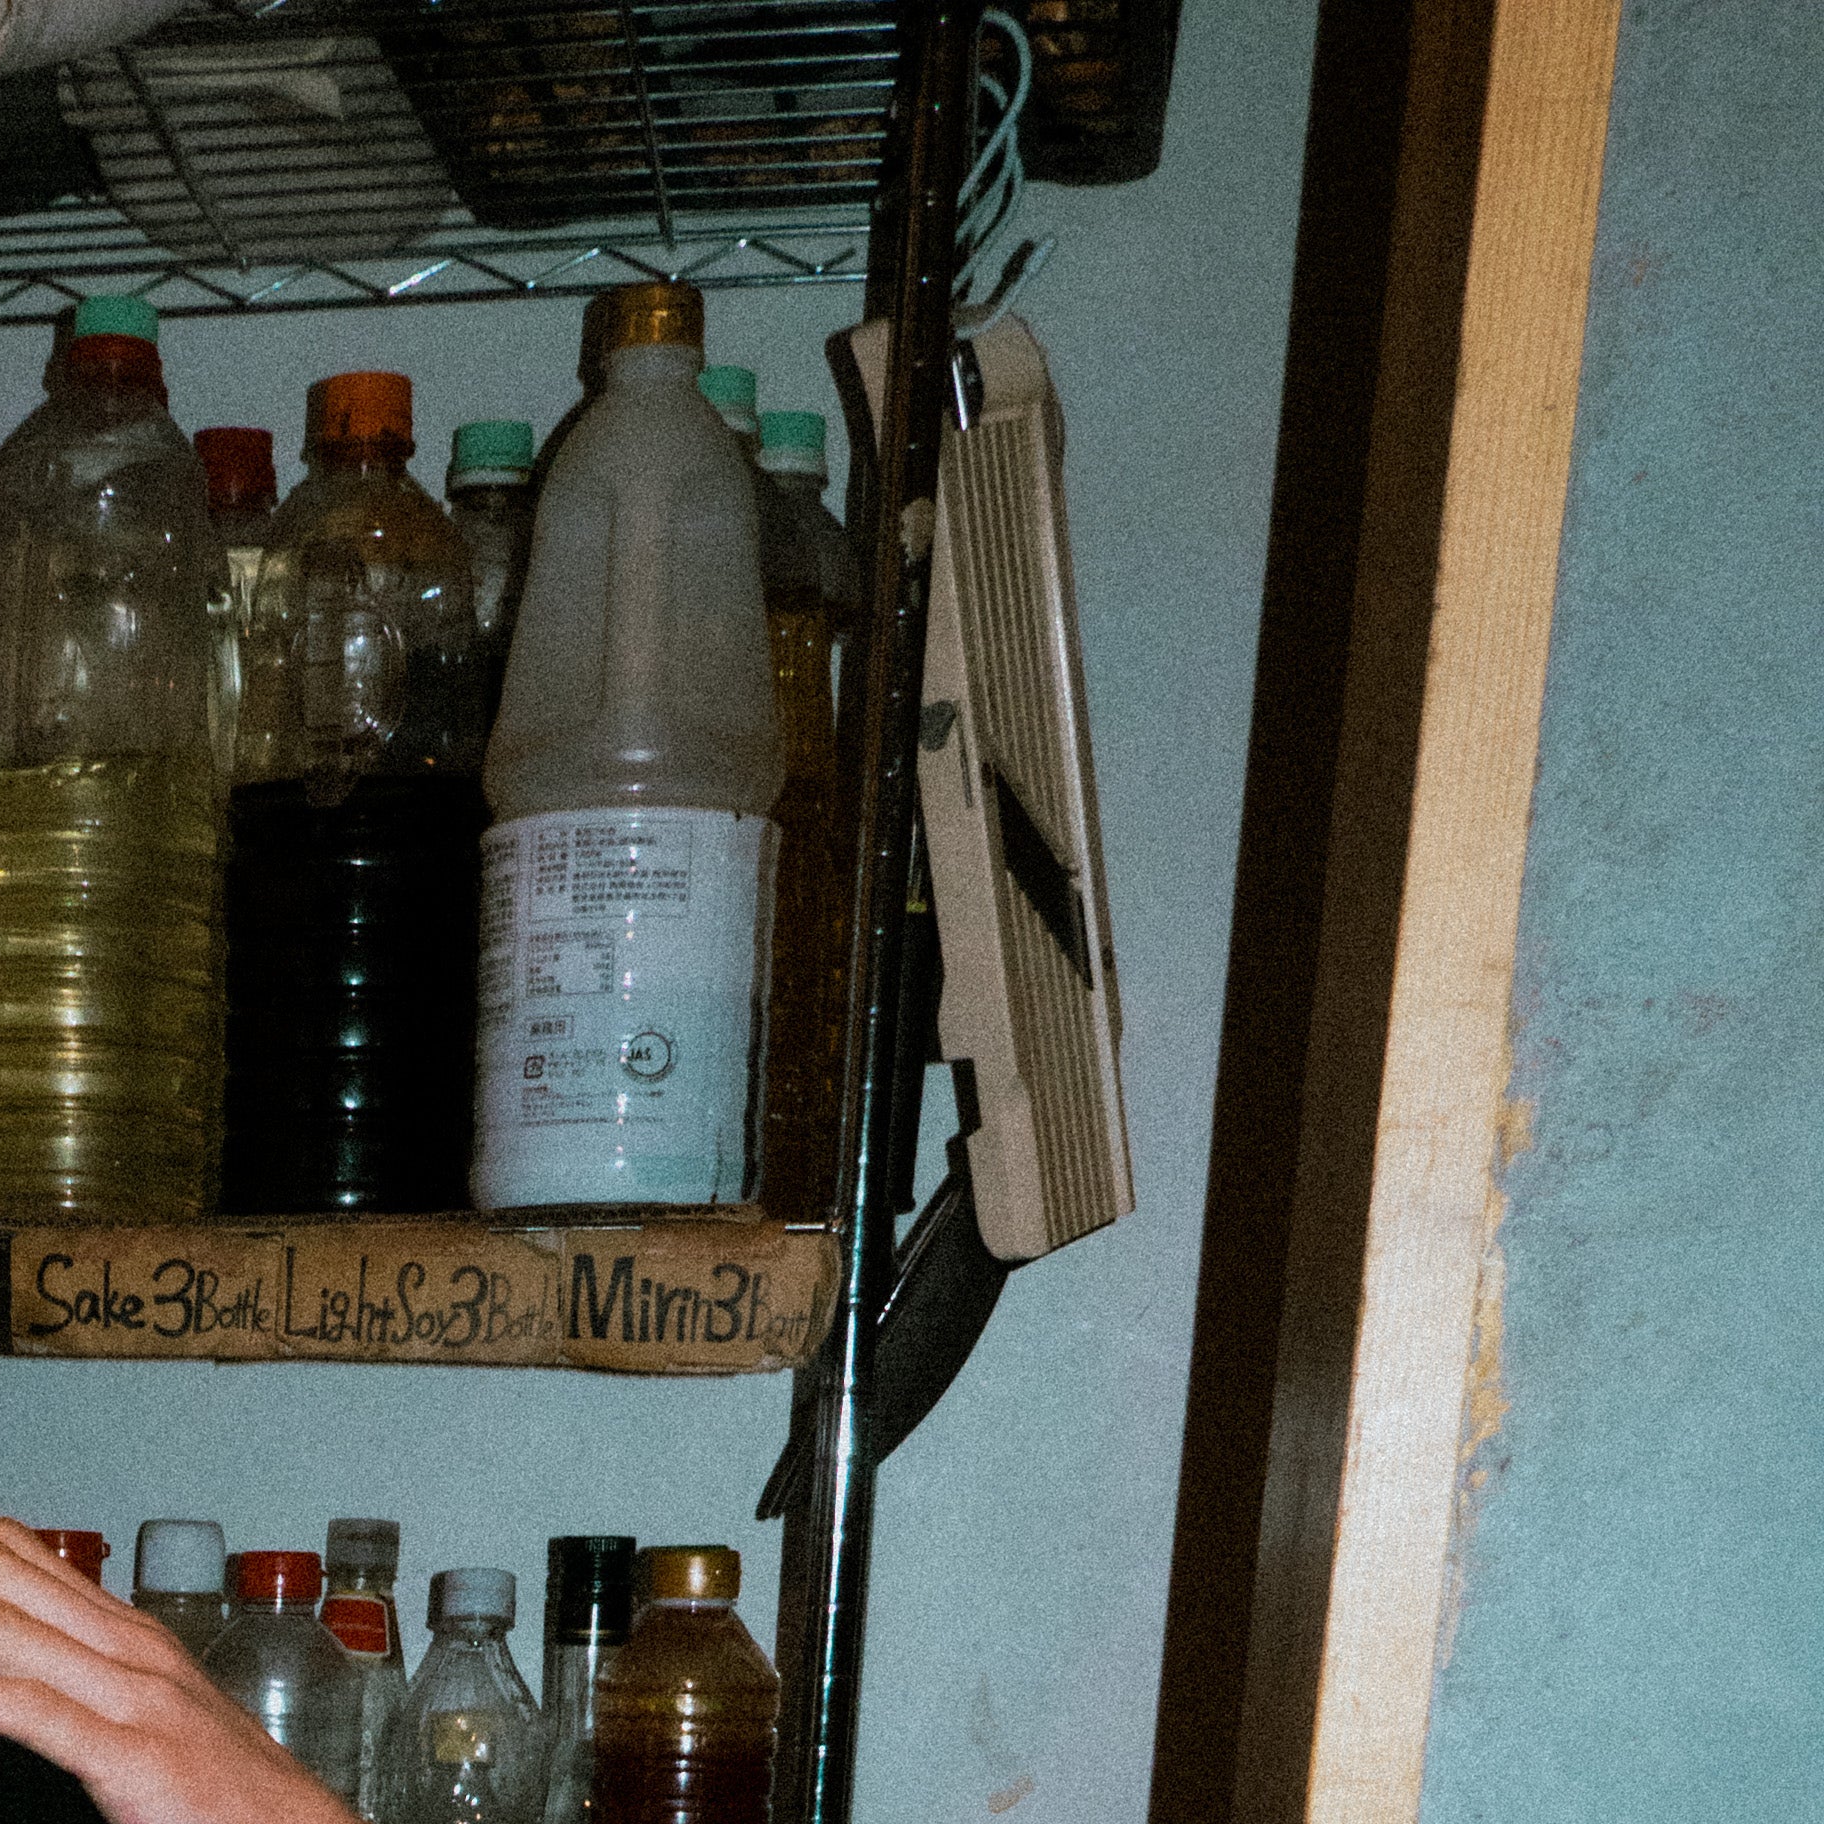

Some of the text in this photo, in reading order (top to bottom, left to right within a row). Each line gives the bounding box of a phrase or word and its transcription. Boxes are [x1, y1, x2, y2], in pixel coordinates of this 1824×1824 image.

[628, 1048, 653, 1062] JAS
[29, 1253, 146, 1336] Sake
[285, 1246, 396, 1346] Light
[391, 1261, 460, 1346] Soy
[568, 1254, 713, 1343] Mirin
